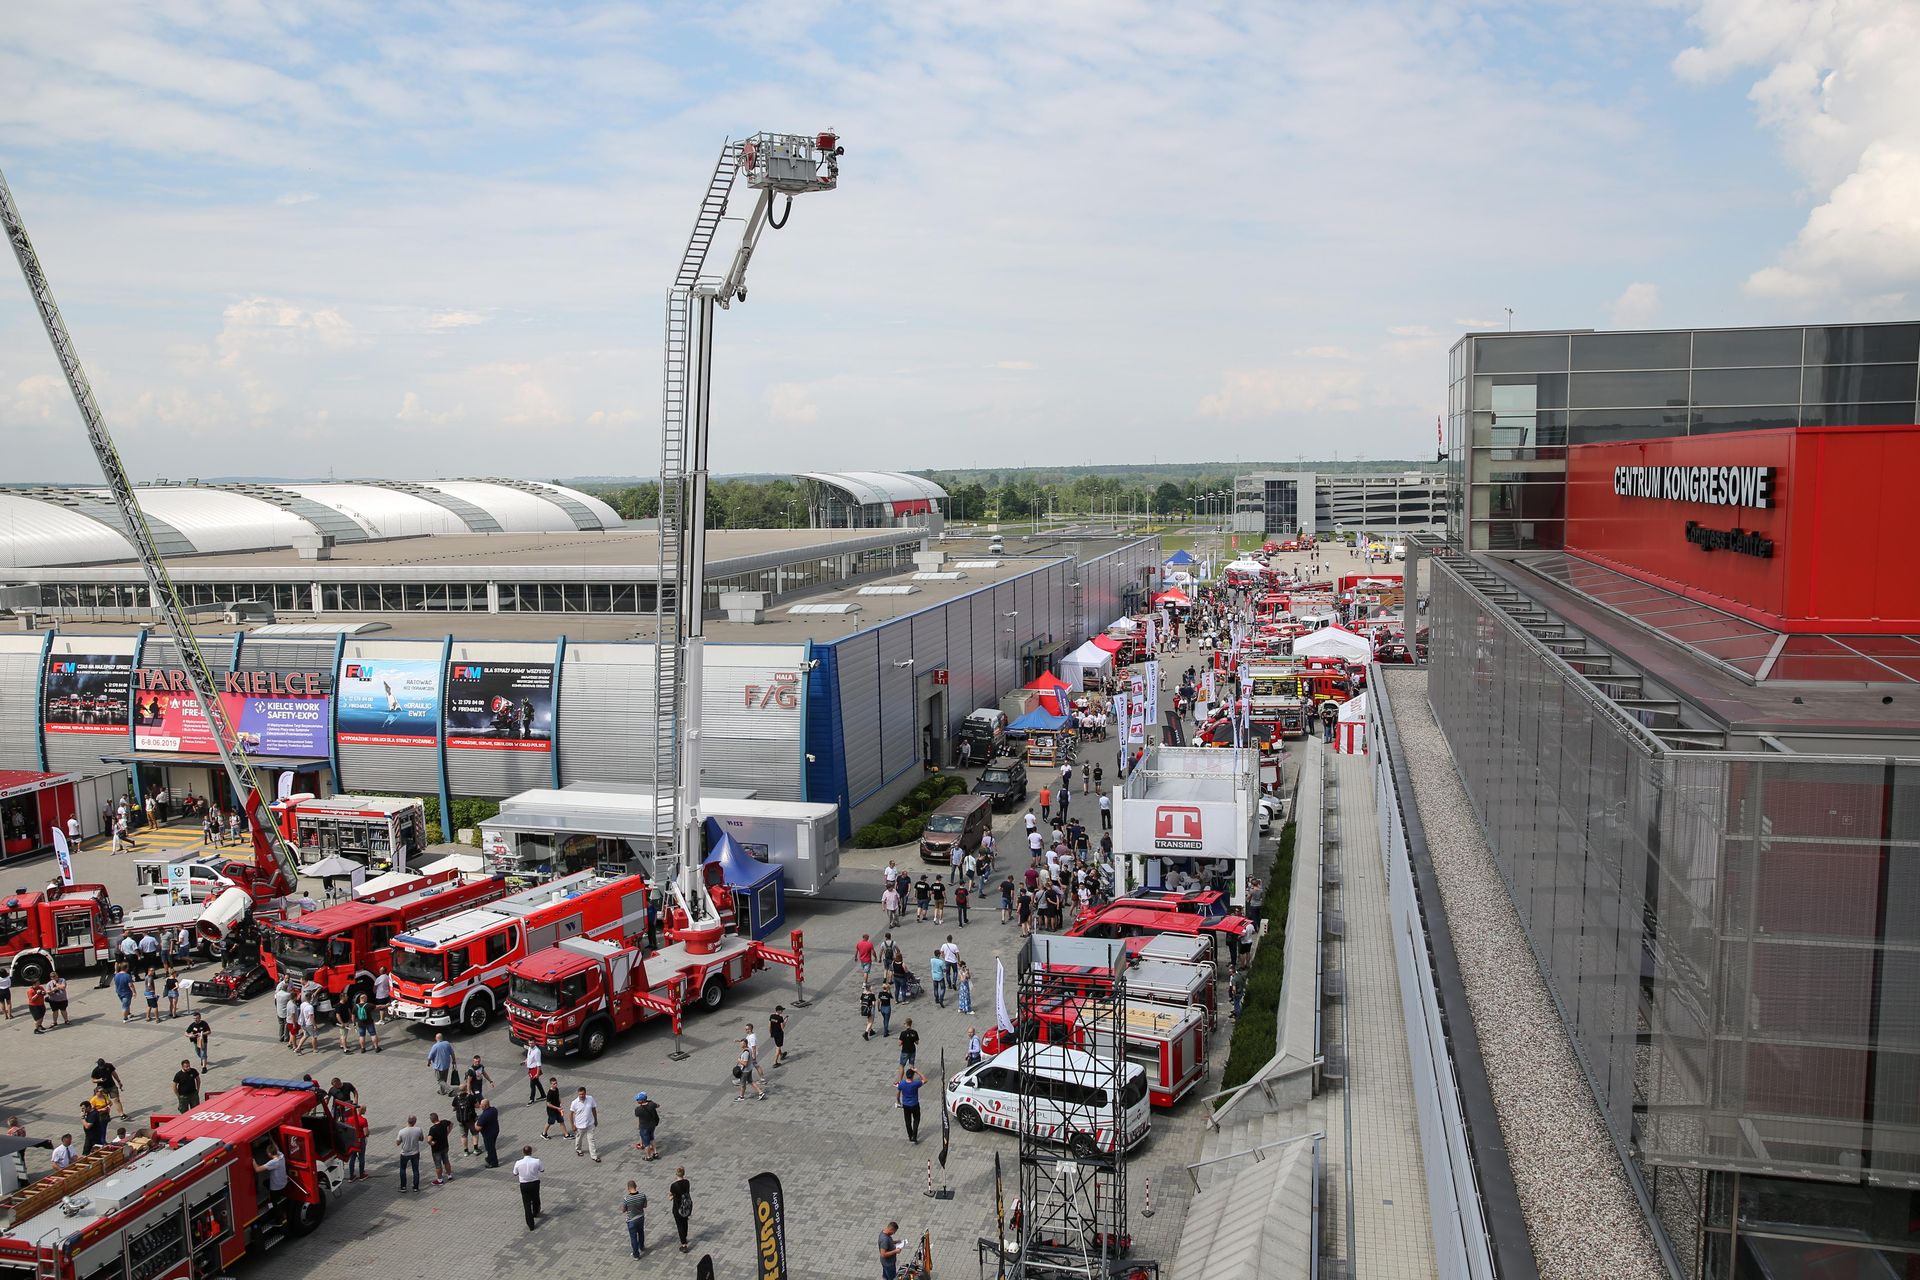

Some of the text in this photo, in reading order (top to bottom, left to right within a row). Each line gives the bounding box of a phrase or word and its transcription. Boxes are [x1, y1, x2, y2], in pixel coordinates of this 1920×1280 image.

[1614, 466, 1768, 509] CENTRUM KONGRESOWE
[938, 670, 945, 678] F
[225, 671, 321, 694] KIELCE
[744, 684, 796, 709] F/G
[267, 702, 320, 711] KIELCE WORK
[267, 711, 319, 720] SAFETY-EXPO
[141, 738, 177, 747] 6-8.06.2019
[1156, 841, 1202, 849] TRANSMED
